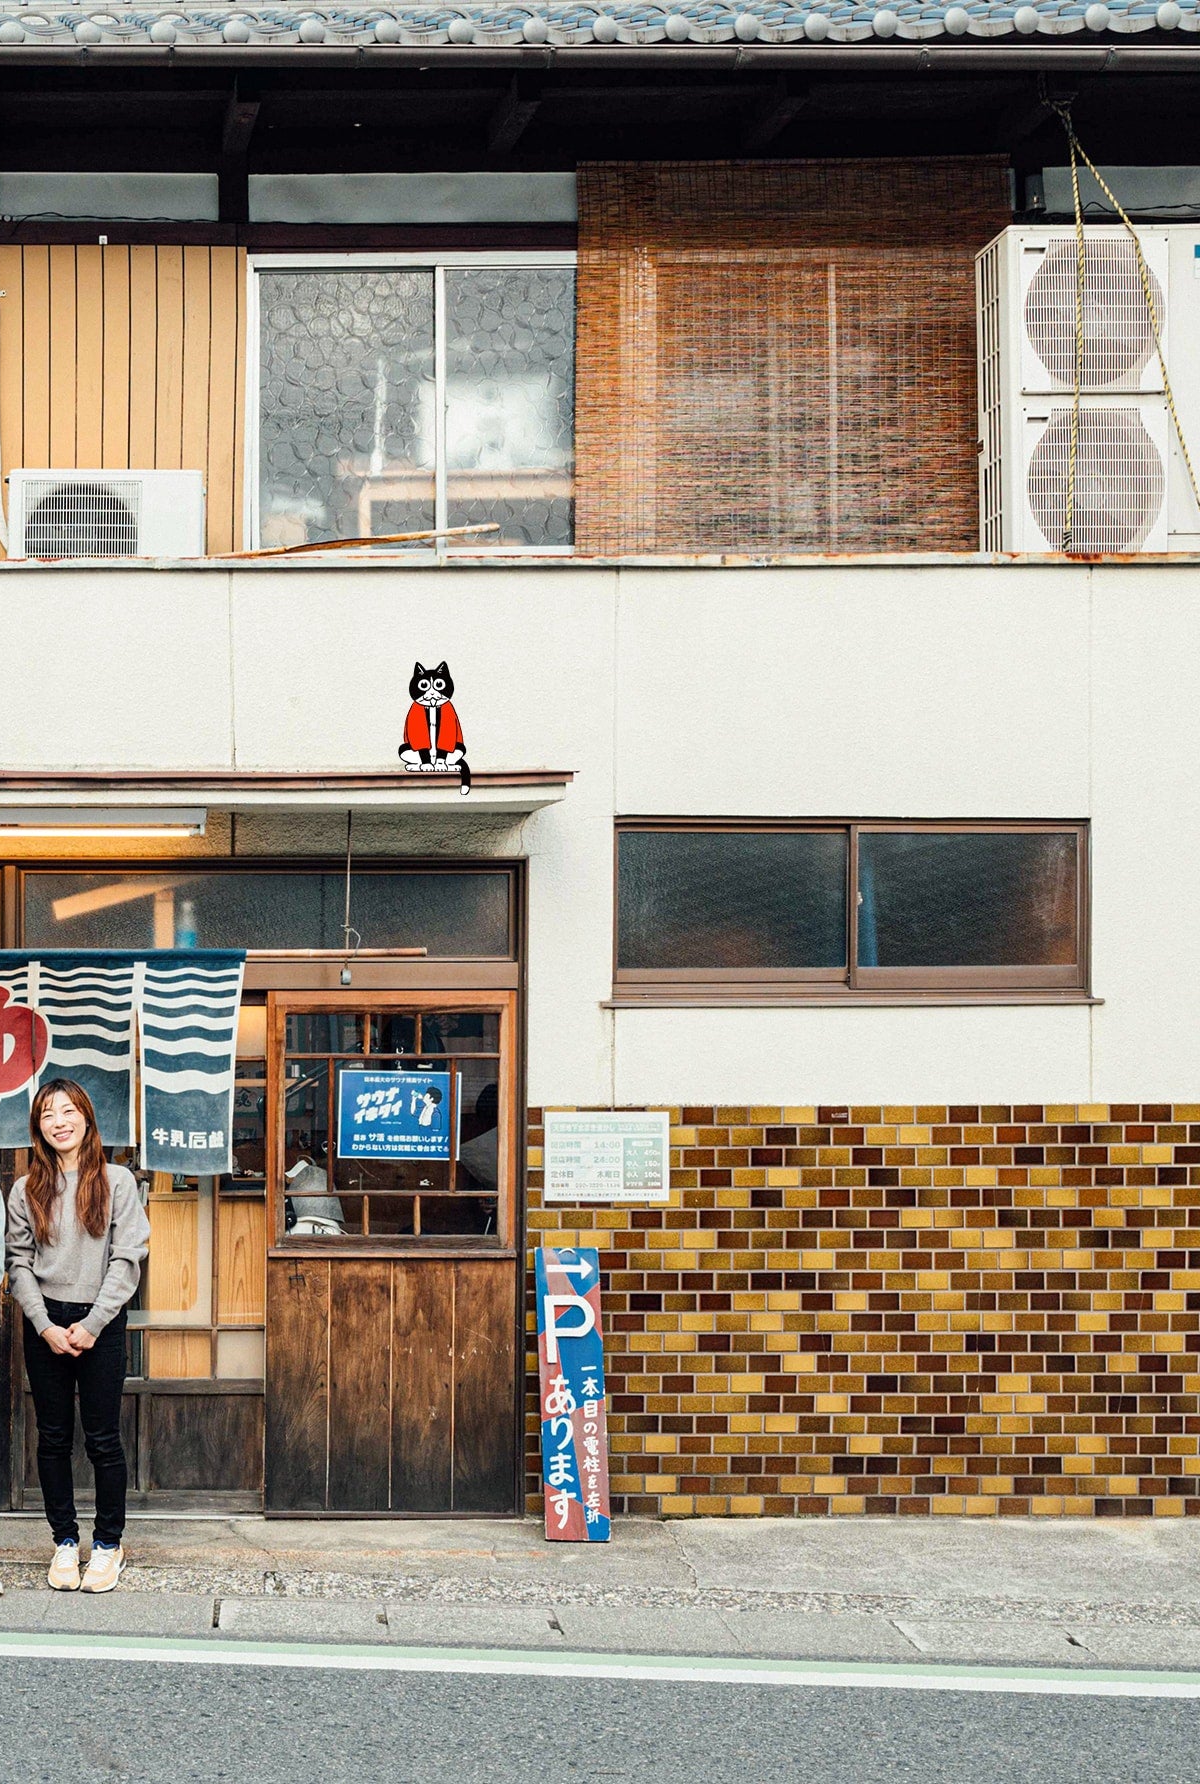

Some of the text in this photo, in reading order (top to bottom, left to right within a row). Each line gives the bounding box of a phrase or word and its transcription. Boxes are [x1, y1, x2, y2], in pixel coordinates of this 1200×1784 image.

[353, 1100, 403, 1124] イキタイ
[356, 1086, 400, 1108] サウナ
[551, 1170, 574, 1179] 定休日
[543, 1294, 596, 1364] P
[544, 1374, 577, 1530] あります
[580, 1365, 601, 1524] 一本目の電柱を左折
